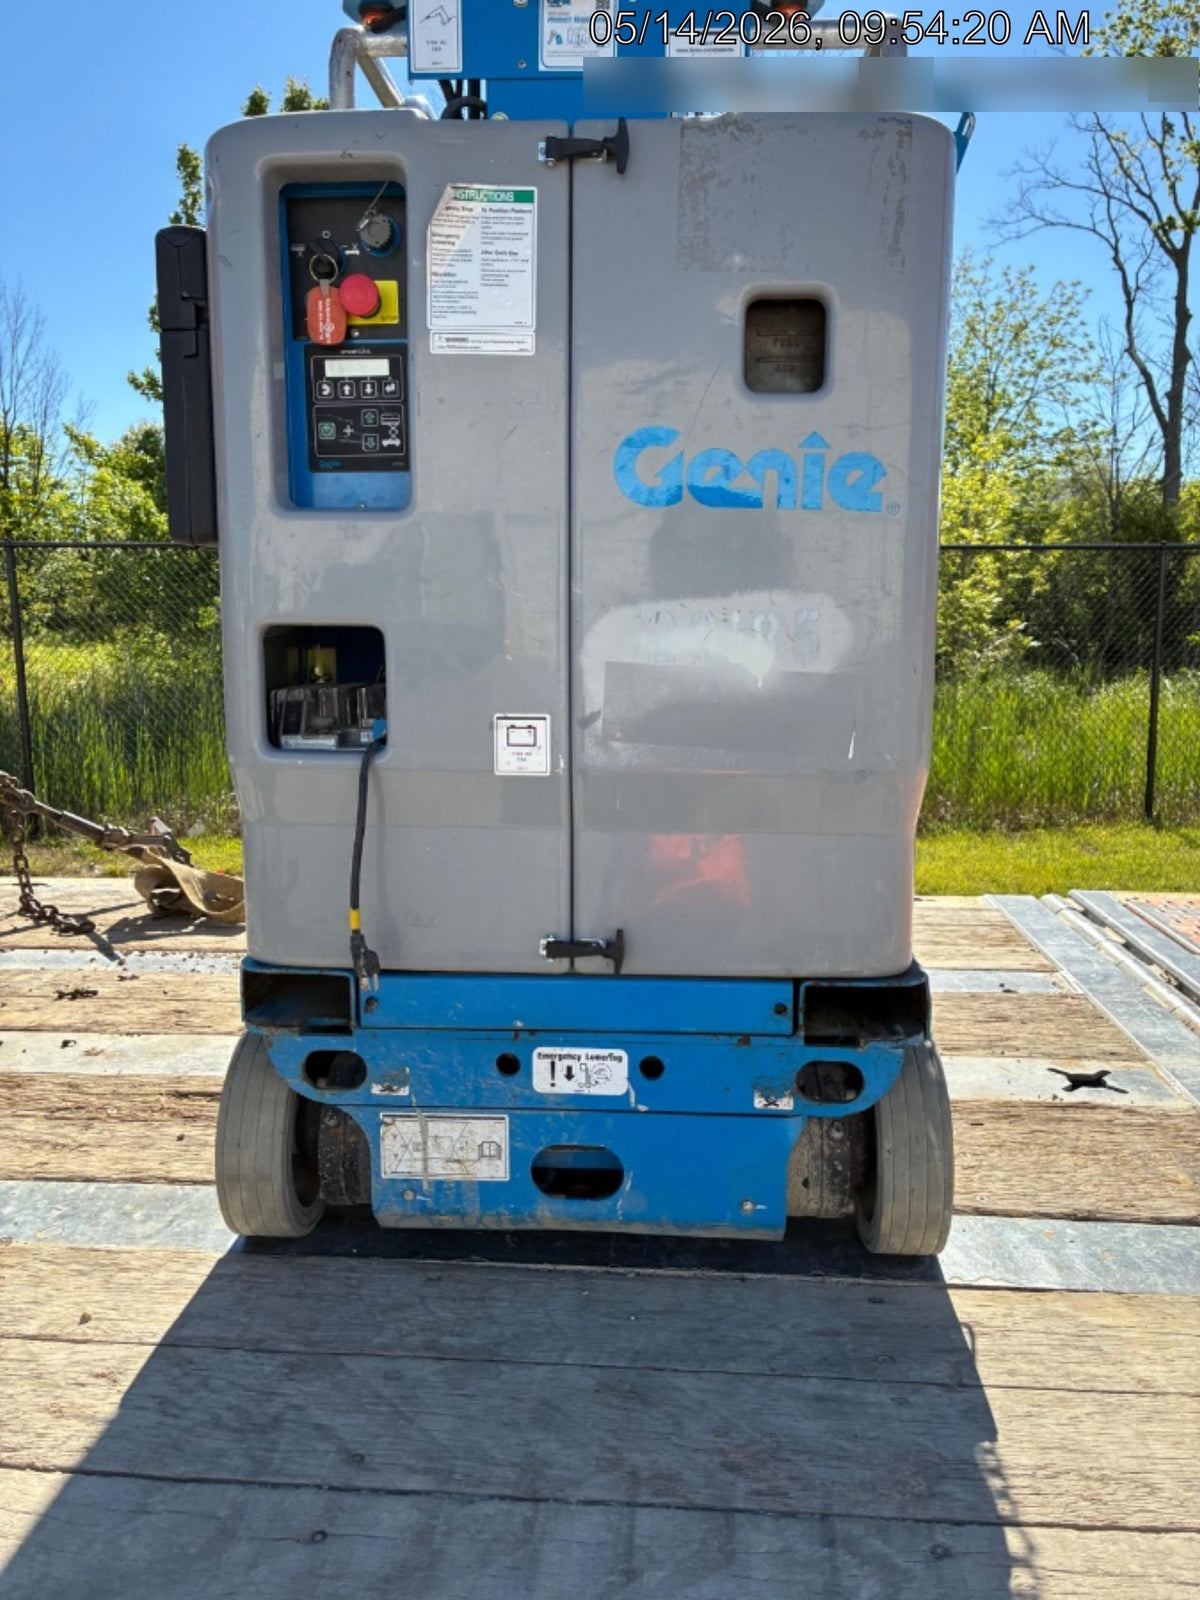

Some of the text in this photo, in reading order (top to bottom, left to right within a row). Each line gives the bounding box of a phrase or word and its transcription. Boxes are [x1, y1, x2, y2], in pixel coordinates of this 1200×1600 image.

[452, 189, 515, 202] NSTRUCTIONS
[613, 424, 887, 513] Genie
[537, 1052, 623, 1063] Emergency Lowering
